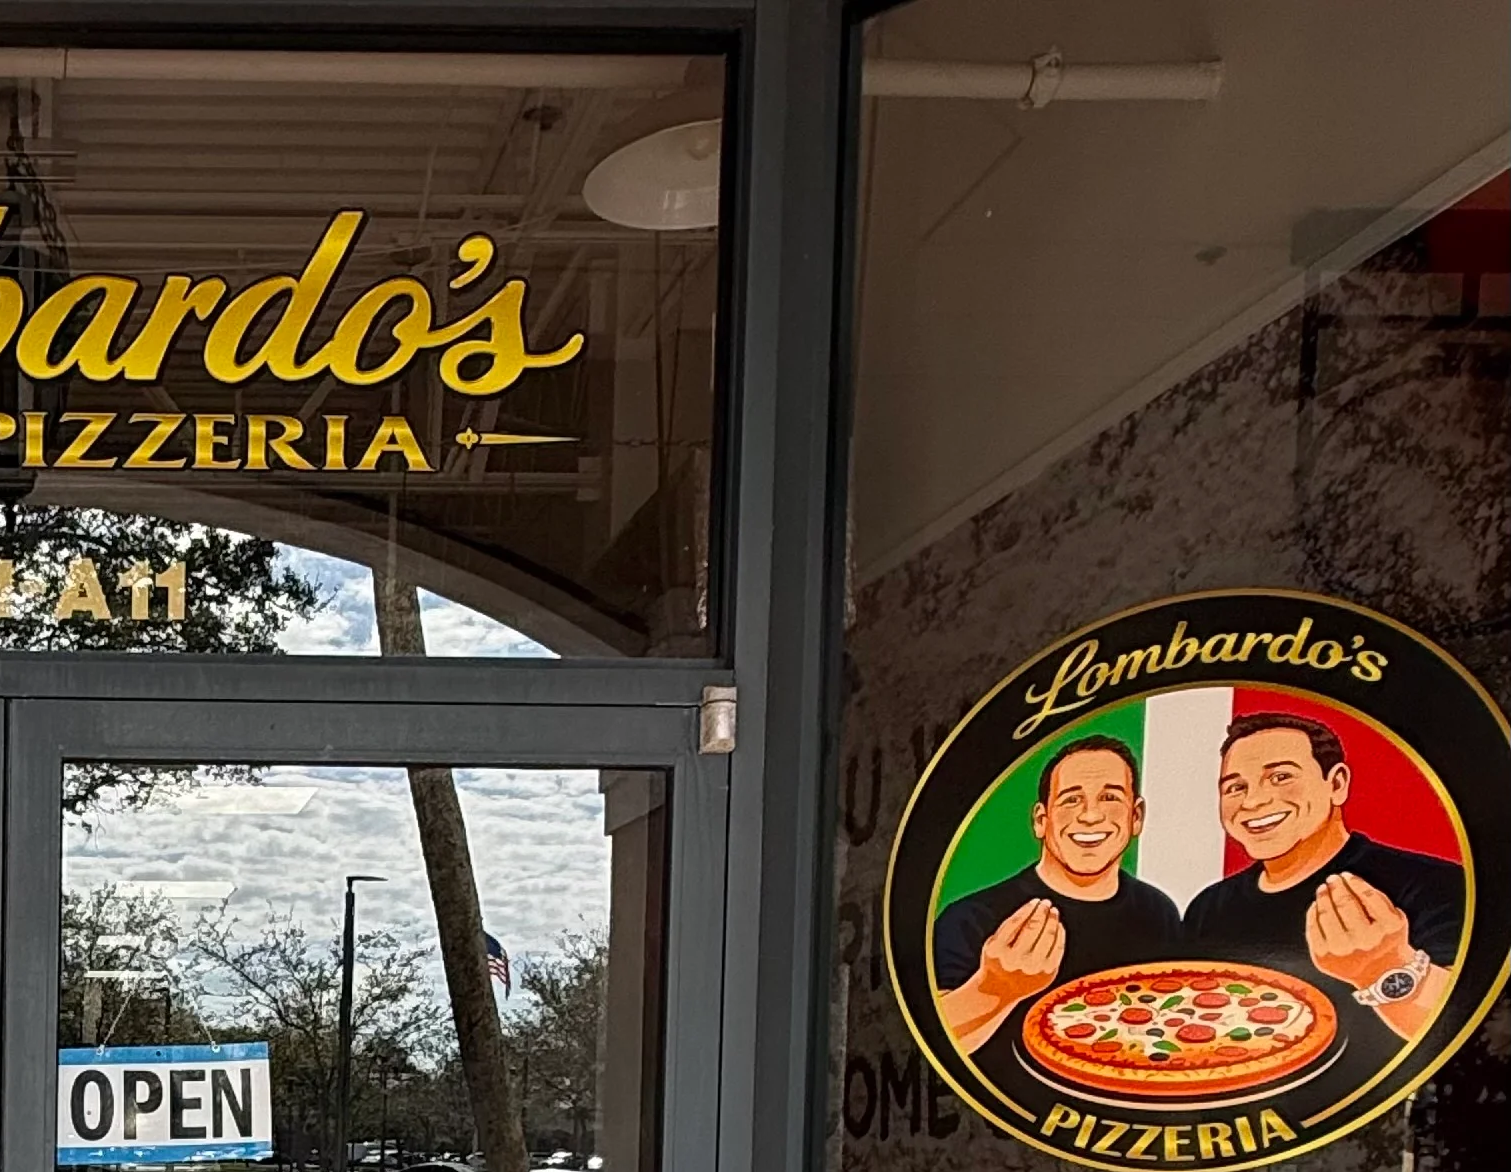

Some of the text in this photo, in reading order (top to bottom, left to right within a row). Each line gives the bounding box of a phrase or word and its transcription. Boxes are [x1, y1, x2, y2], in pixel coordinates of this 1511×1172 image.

[1012, 617, 1389, 740] Lombardo's
[70, 1068, 253, 1141] OPEN
[1040, 1103, 1297, 1162] PIZZERIA
